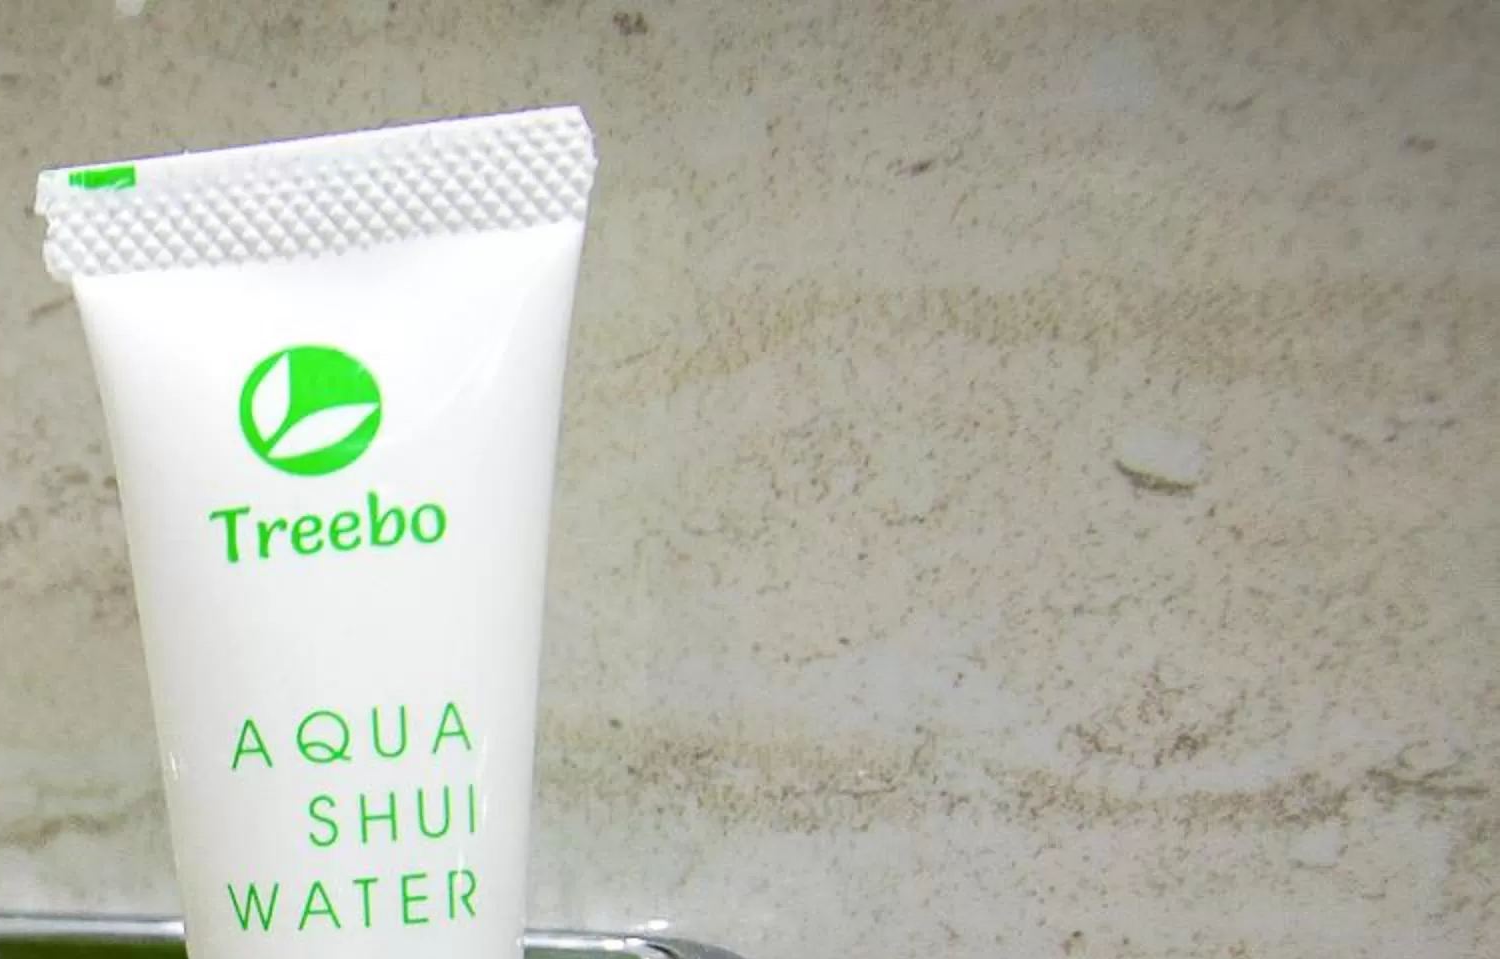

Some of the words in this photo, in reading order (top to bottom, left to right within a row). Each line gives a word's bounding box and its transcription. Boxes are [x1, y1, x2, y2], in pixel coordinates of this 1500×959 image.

[209, 490, 448, 564] Treebo
[231, 701, 473, 771] AQUA
[308, 783, 476, 847] SHUI
[227, 868, 478, 931] WATER
